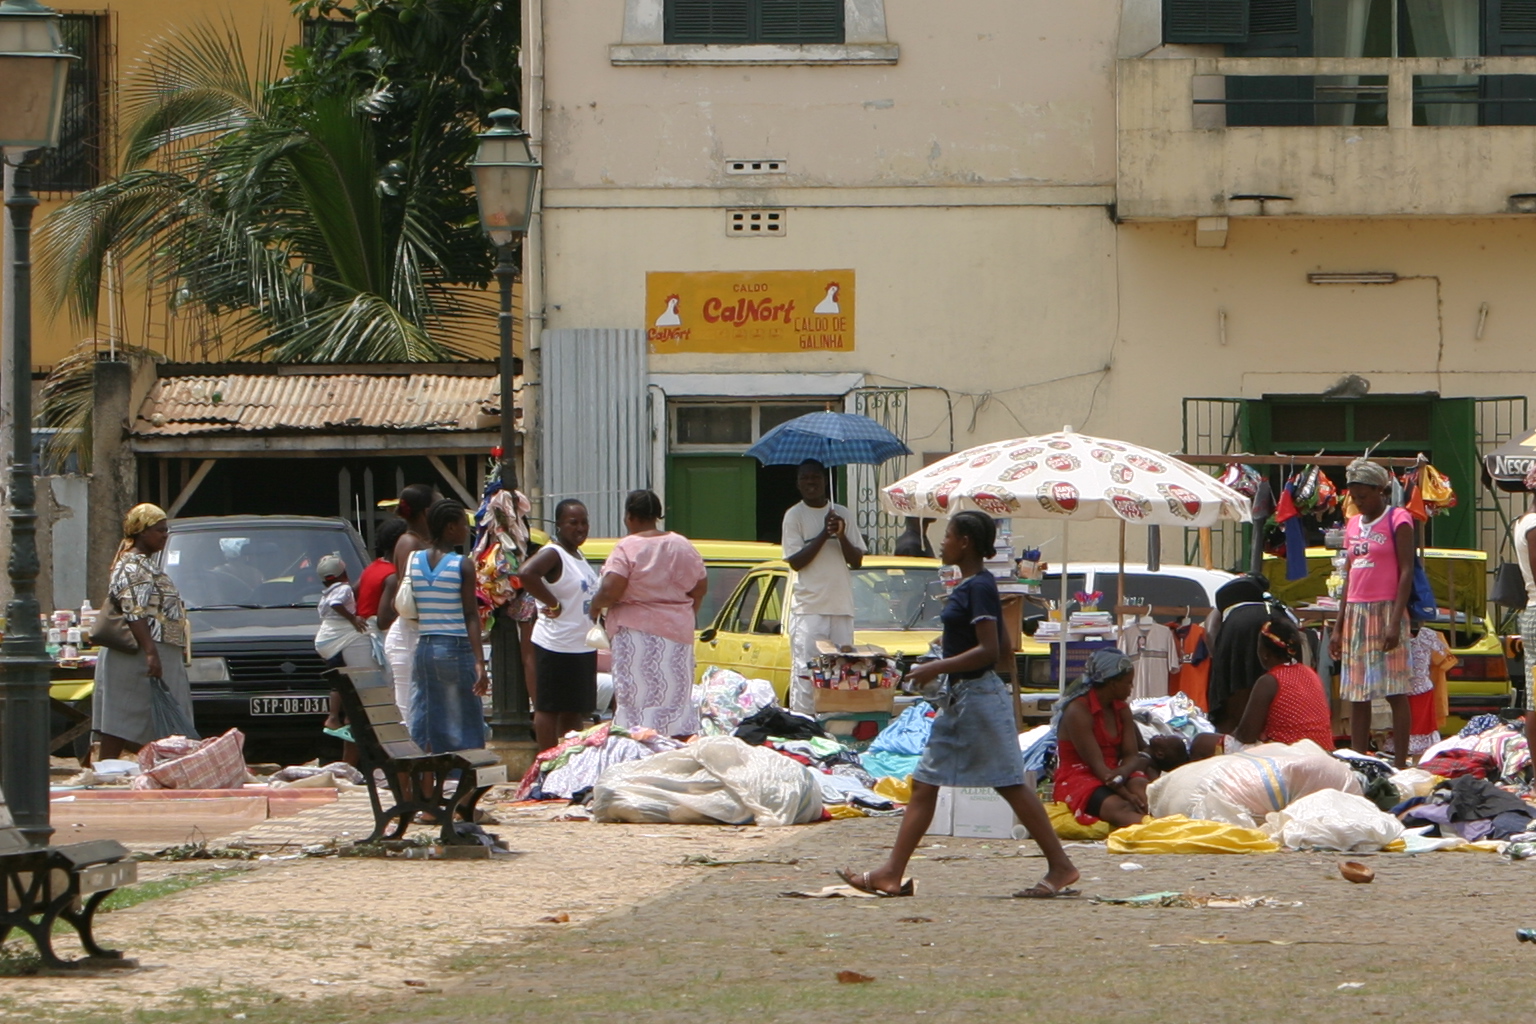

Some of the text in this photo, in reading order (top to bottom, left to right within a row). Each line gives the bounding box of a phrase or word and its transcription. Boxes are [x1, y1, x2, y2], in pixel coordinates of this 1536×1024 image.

[733, 283, 768, 293] CALDO
[703, 297, 795, 327] CalNort
[794, 316, 847, 332] CALDO DE
[648, 327, 691, 343] CalNort
[799, 334, 844, 349] GALINHA
